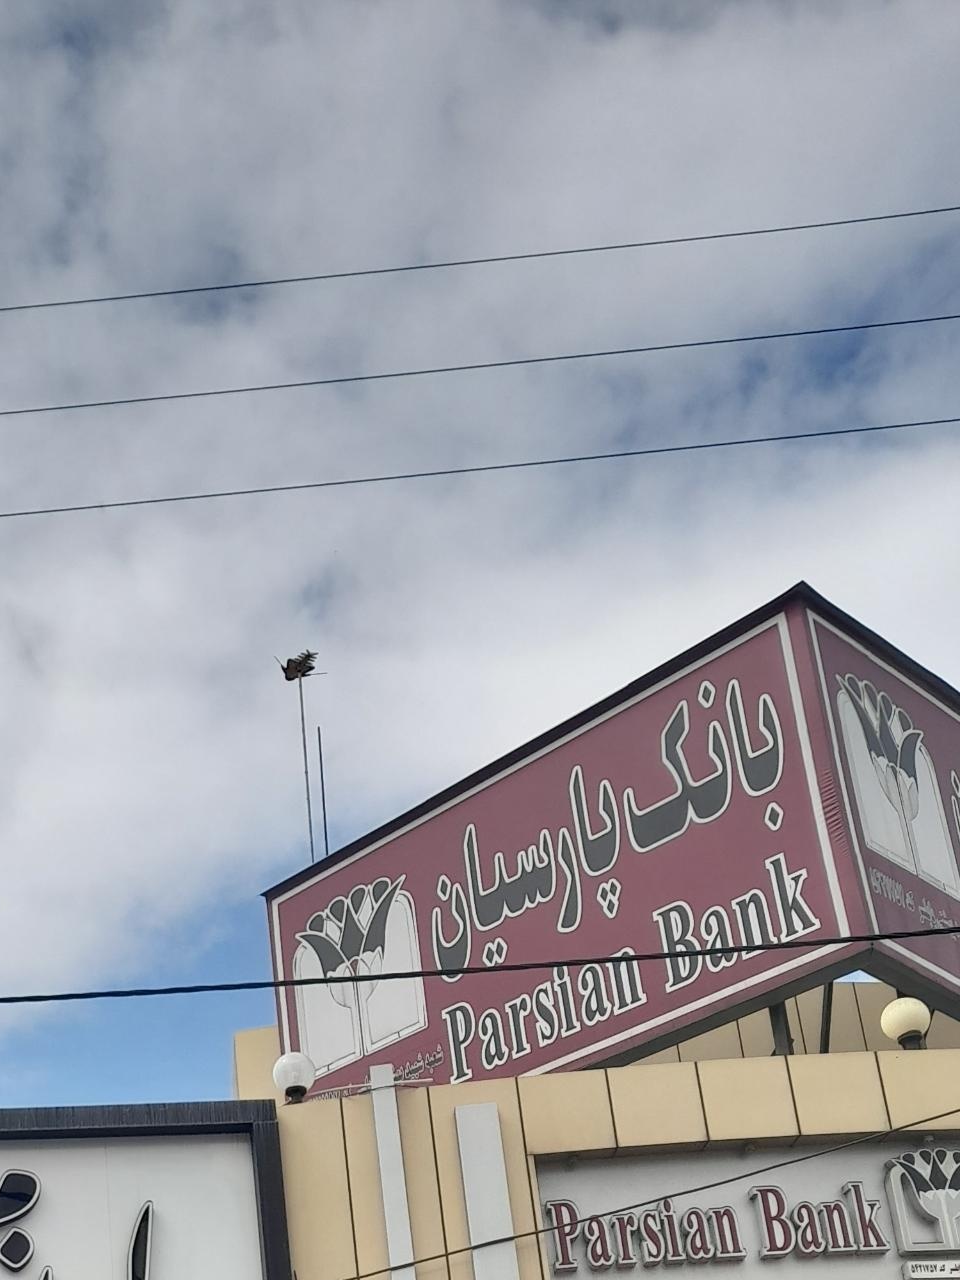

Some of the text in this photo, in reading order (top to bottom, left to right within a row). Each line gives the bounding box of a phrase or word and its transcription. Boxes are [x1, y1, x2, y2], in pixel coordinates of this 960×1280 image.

[431, 679, 784, 984] بانک پارسیان
[442, 851, 821, 1085] Parsian Bank
[545, 1181, 891, 1273] Parsian Bank
